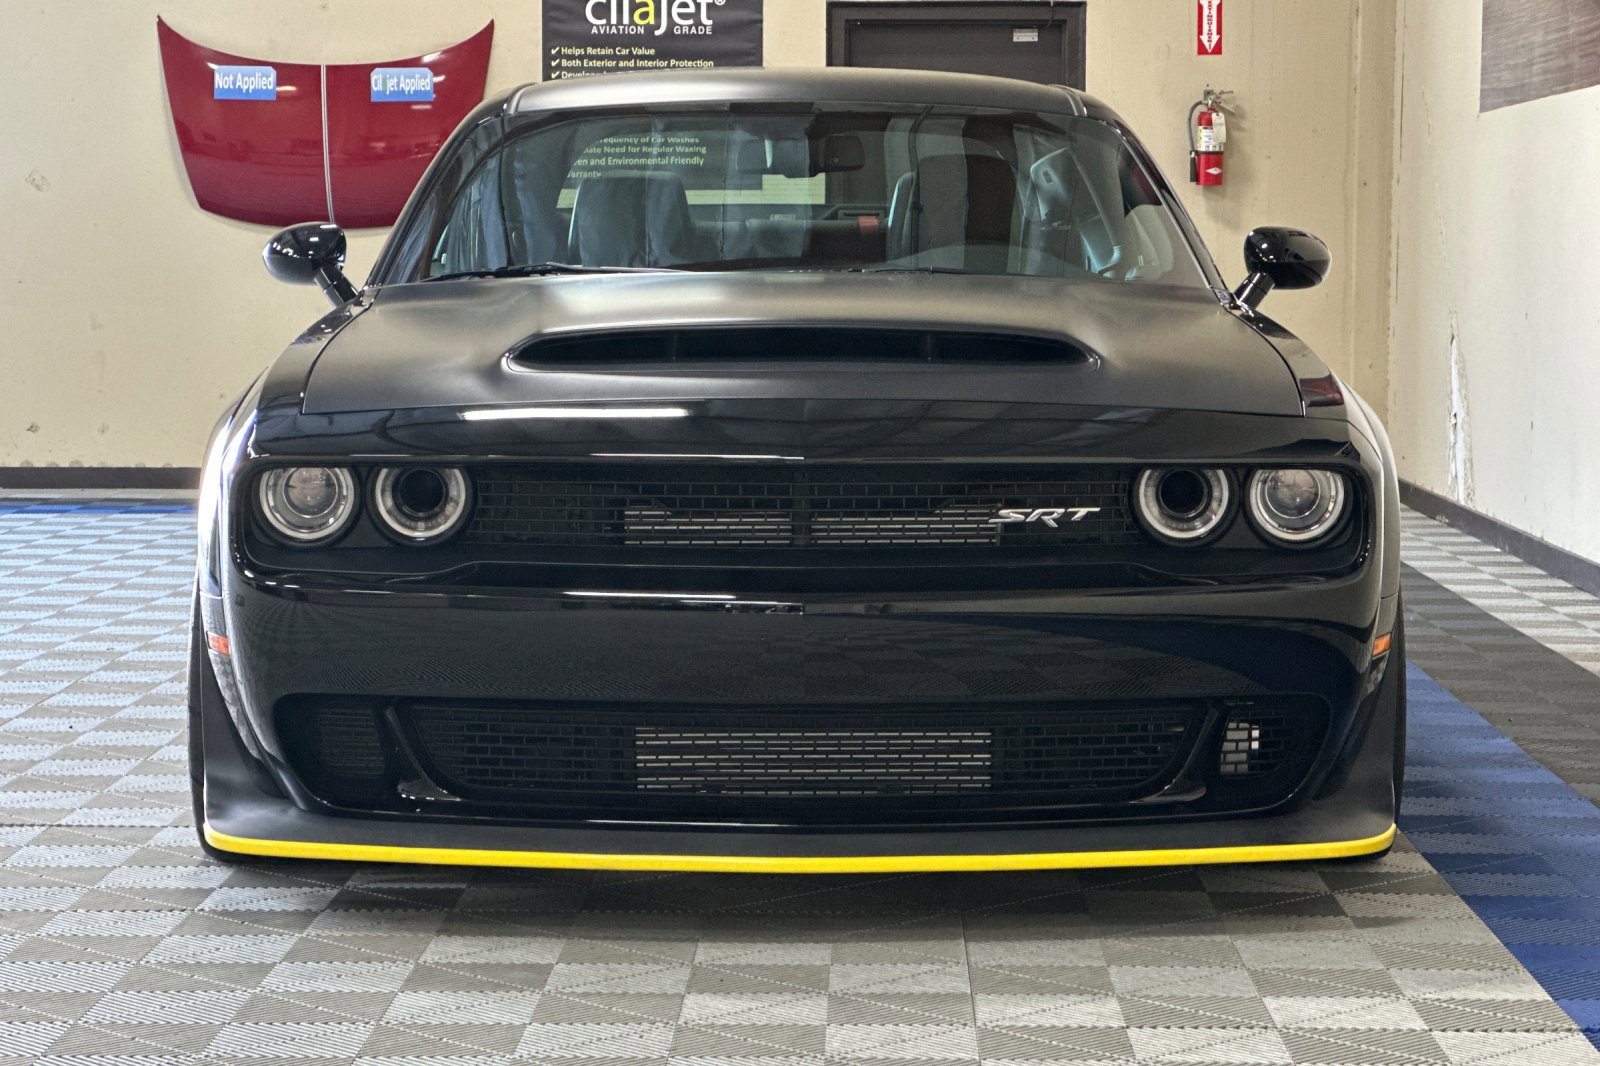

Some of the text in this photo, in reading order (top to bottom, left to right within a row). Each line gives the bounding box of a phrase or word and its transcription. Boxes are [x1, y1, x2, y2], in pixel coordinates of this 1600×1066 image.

[591, 25, 713, 35] AVIATION GRADE
[561, 46, 655, 56] Helps Retain Car Value
[561, 58, 714, 67] Both Exterior and Interior Protection
[215, 72, 274, 93] Not Applied
[399, 73, 431, 94] Applied
[603, 145, 627, 153] Need
[628, 145, 641, 153] for
[642, 145, 674, 155] Regular
[675, 145, 707, 154] Waxing
[589, 157, 606, 166] and
[607, 156, 669, 165] Environmental
[670, 156, 704, 167] Friendly
[988, 507, 1101, 528] SRT
